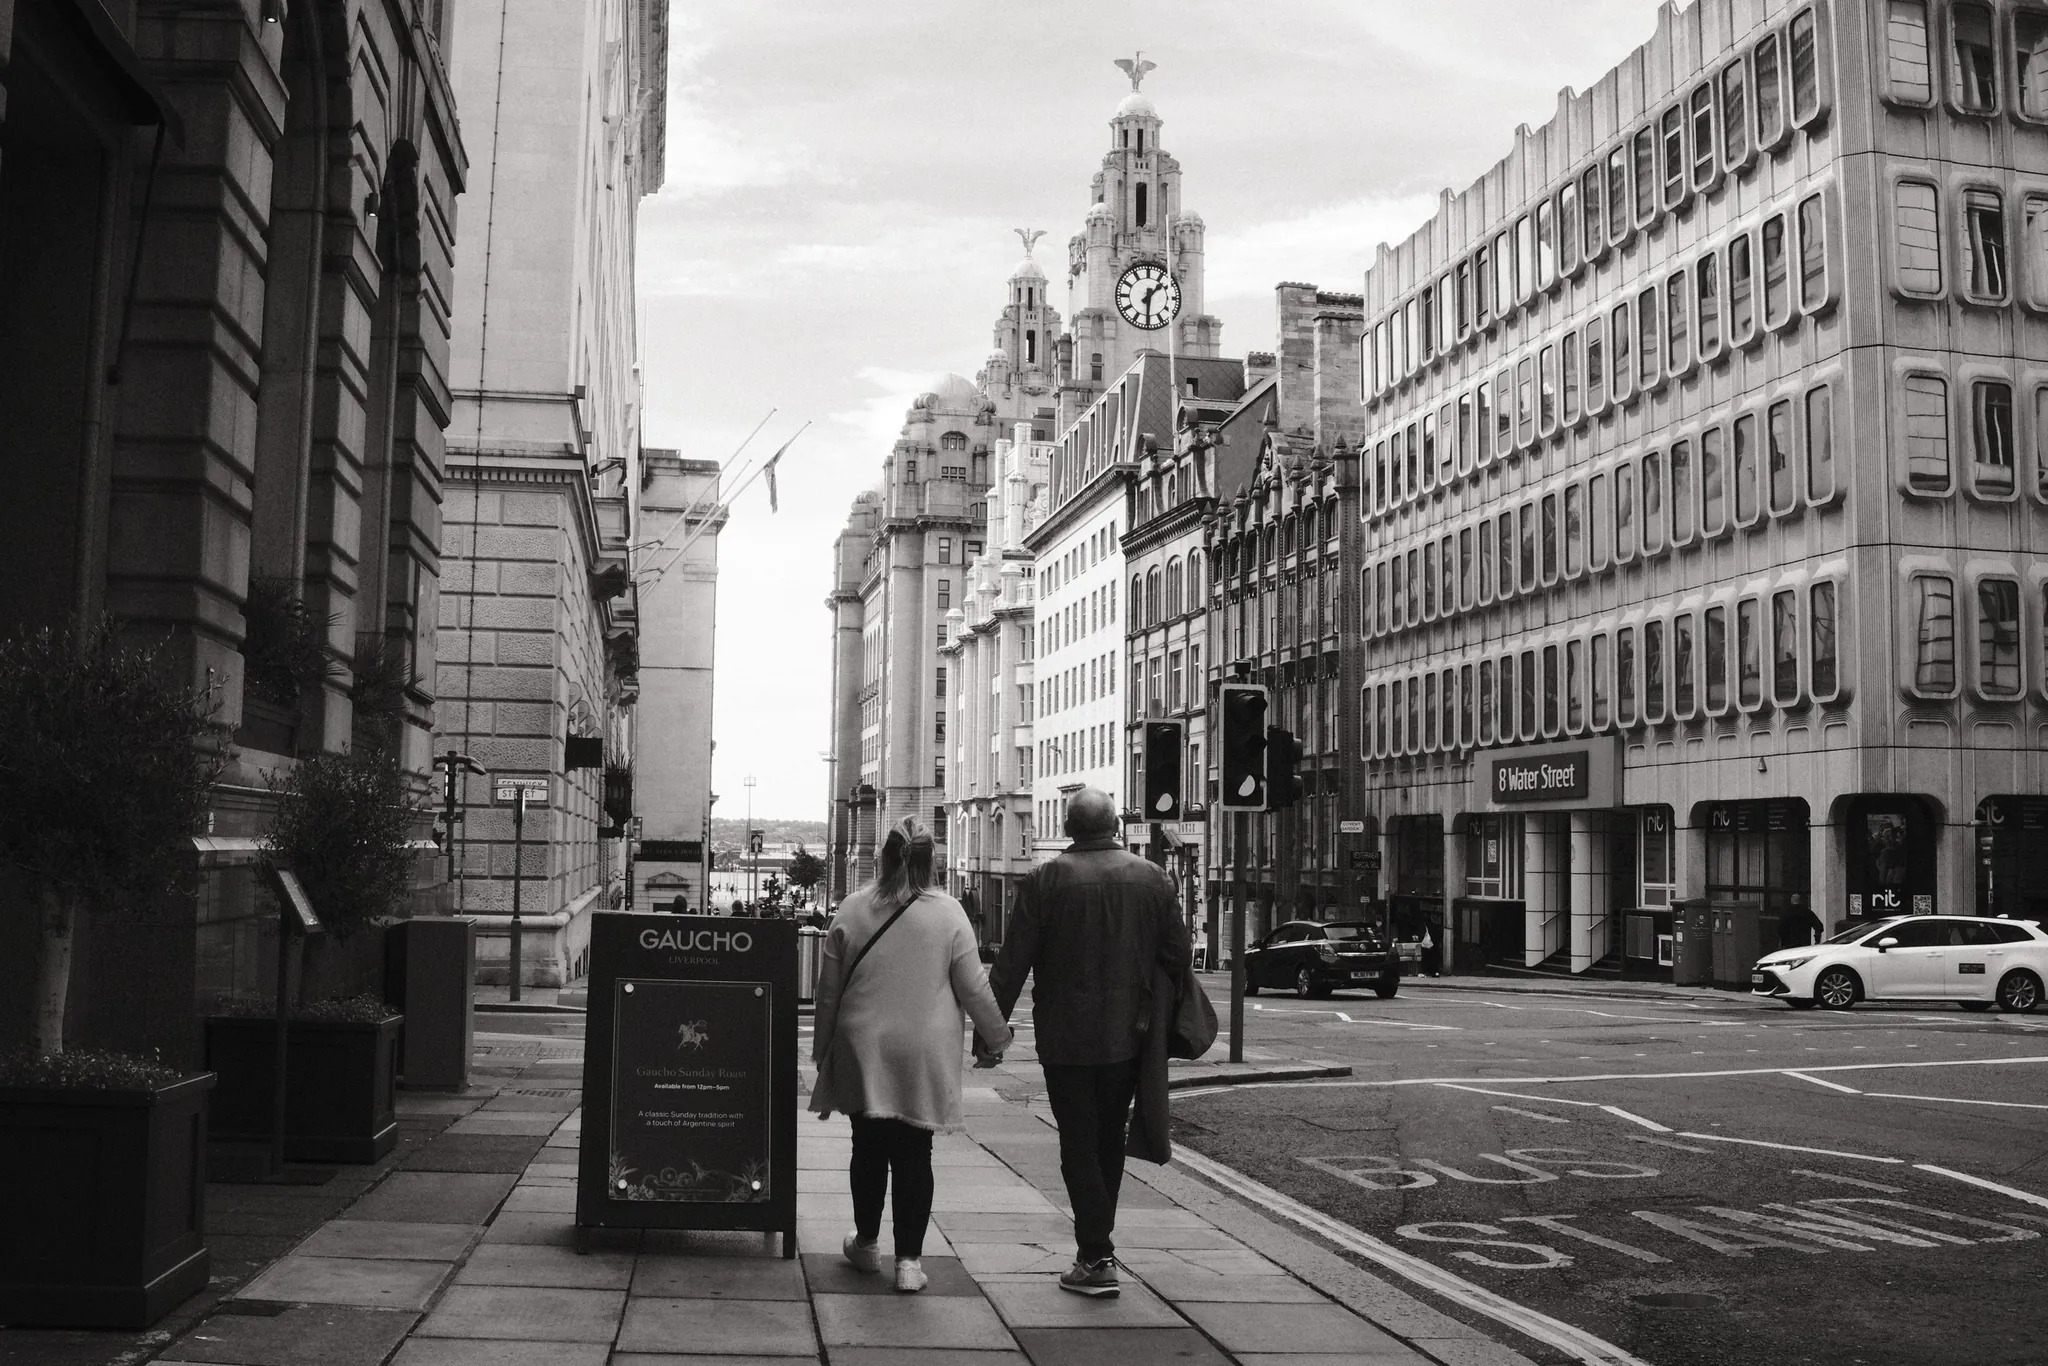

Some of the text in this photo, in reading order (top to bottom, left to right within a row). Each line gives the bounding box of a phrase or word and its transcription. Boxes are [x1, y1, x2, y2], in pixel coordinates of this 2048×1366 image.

[1499, 764, 1575, 792] 8 Water Street
[1647, 810, 1664, 833] rit
[1871, 888, 1901, 907] rit
[639, 928, 753, 953] GAUCHO
[669, 955, 719, 965] LIVERPOOL
[636, 1066, 747, 1080] Gaucho Sunday Roast
[671, 1111, 697, 1119] Sunday
[682, 1120, 716, 1128] Argentine
[1297, 1147, 1661, 1191] BUS
[1395, 1197, 2042, 1270] STAND
